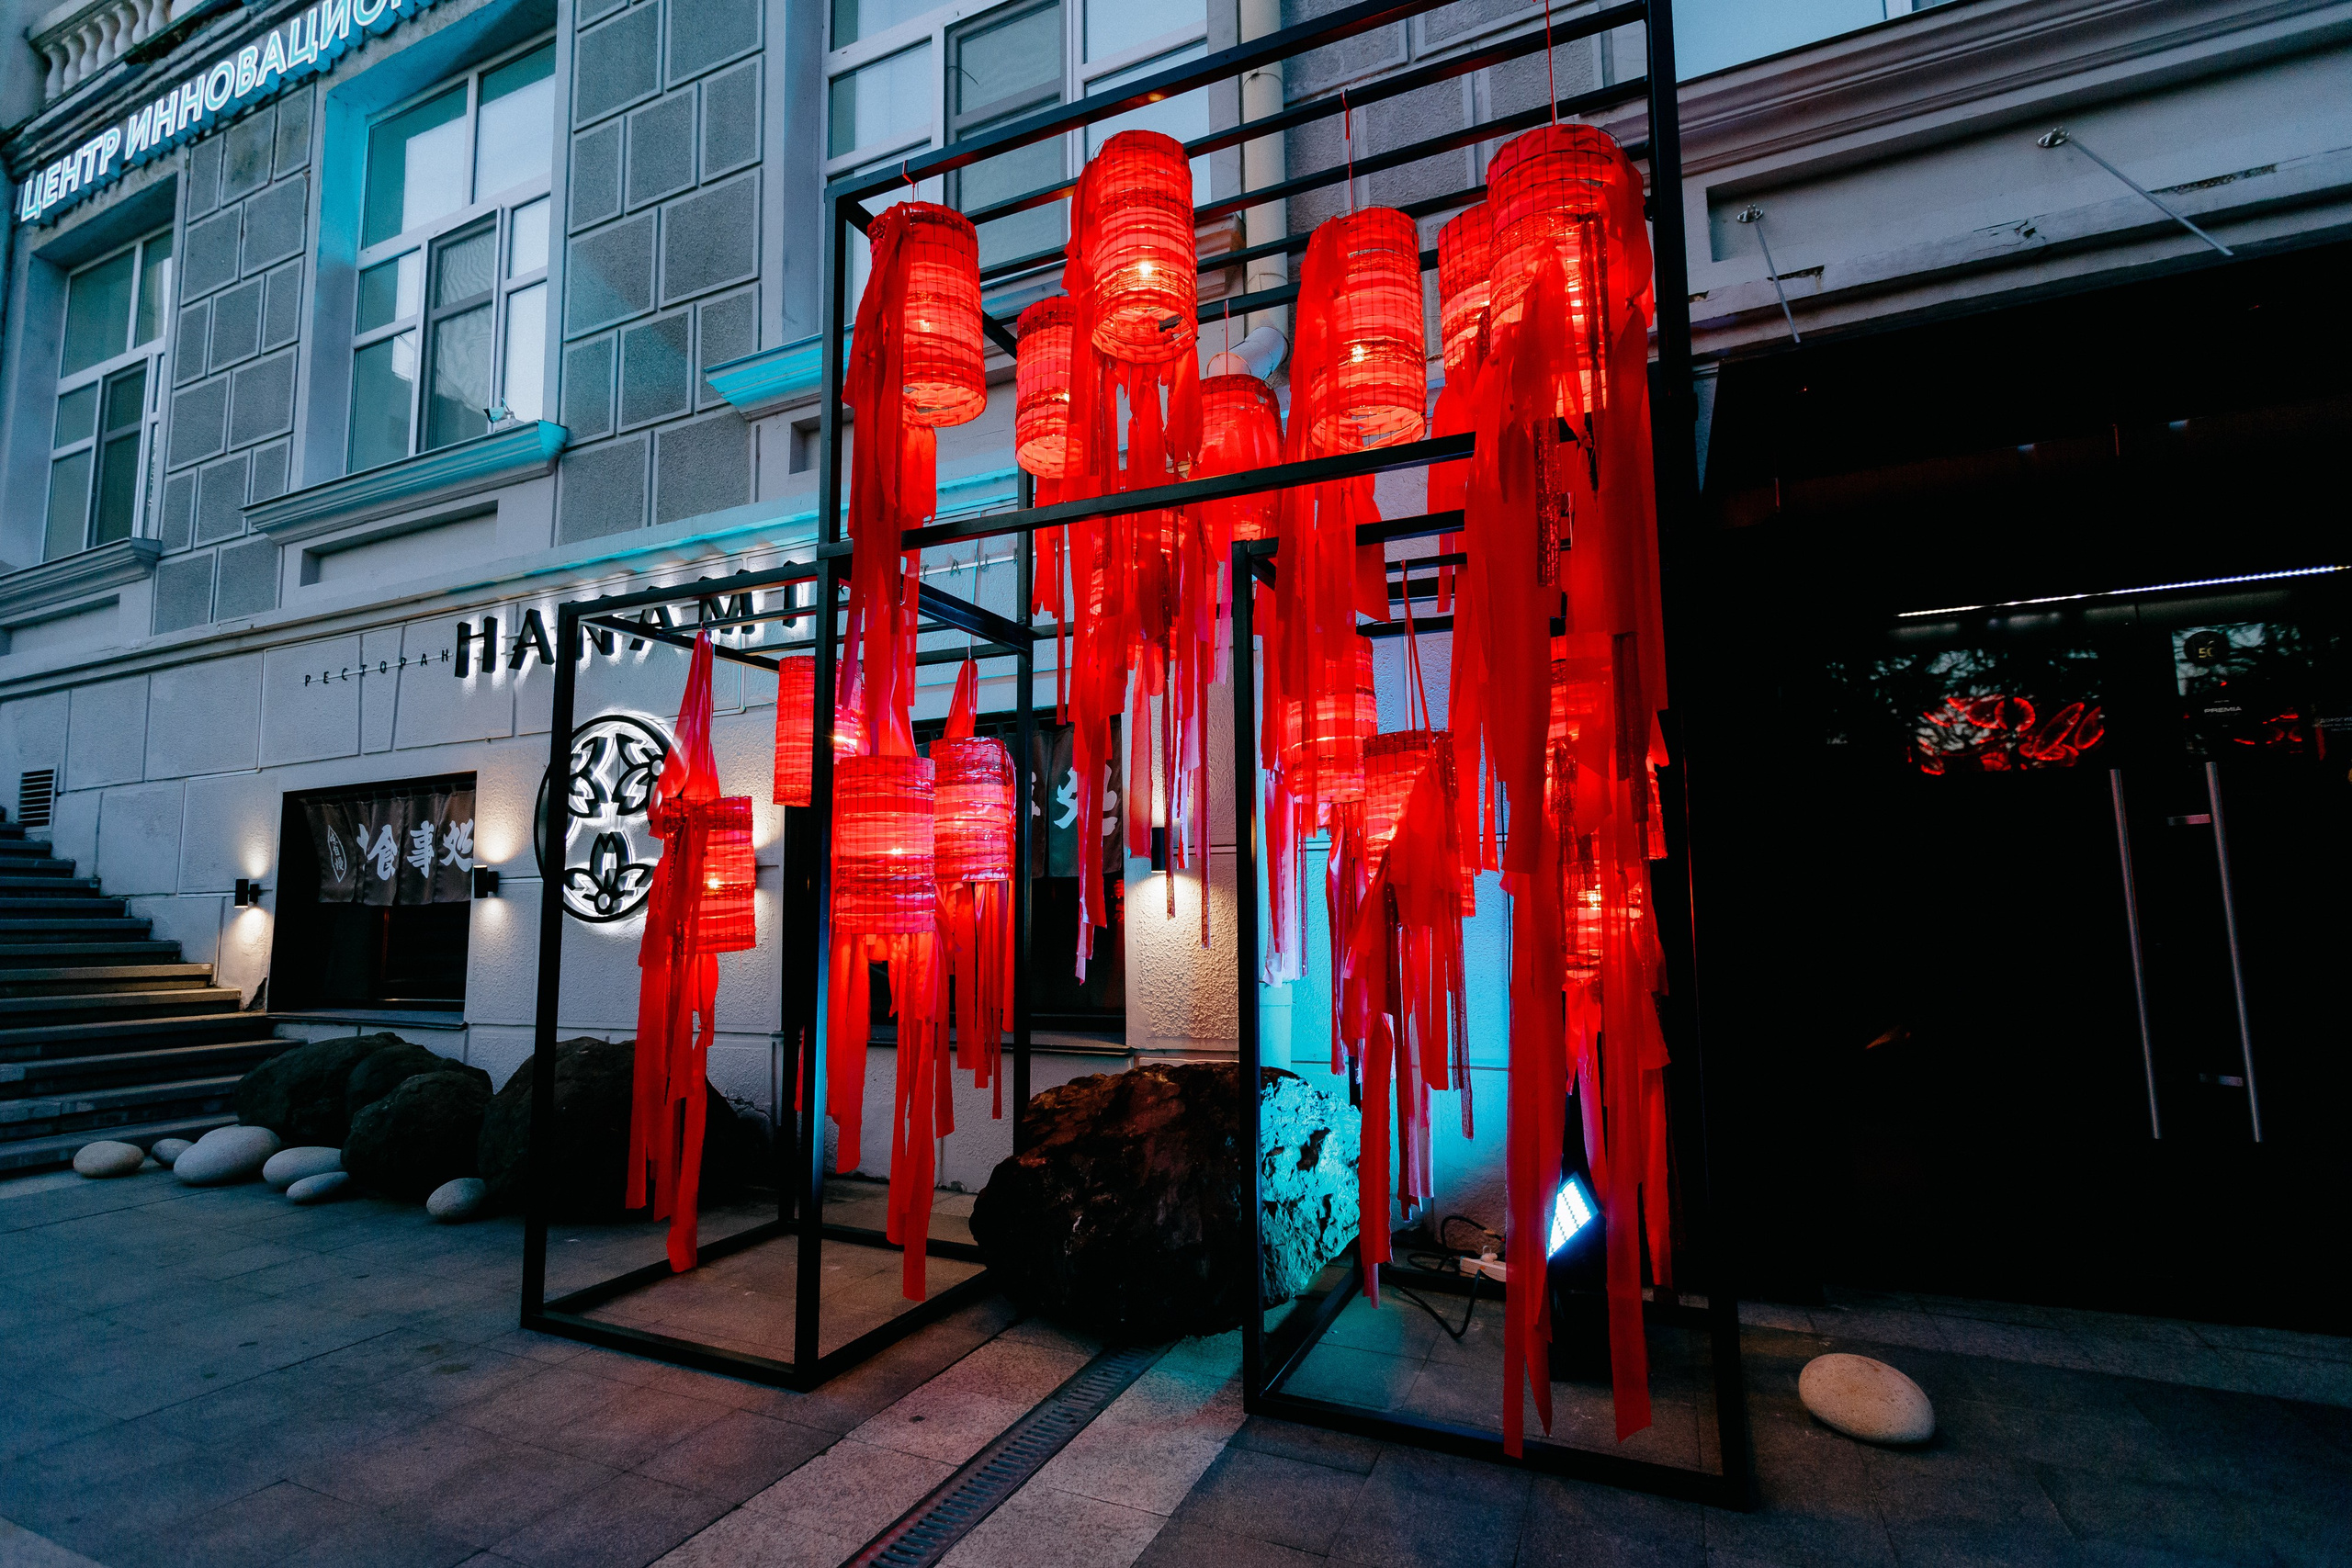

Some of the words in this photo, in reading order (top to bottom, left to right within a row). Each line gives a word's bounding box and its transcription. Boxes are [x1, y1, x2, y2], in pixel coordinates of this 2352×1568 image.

[20, 127, 121, 222] ЦЕНТР
[124, 0, 402, 161] ИННОВАЦИО
[304, 649, 449, 687] РЕСТОРАН
